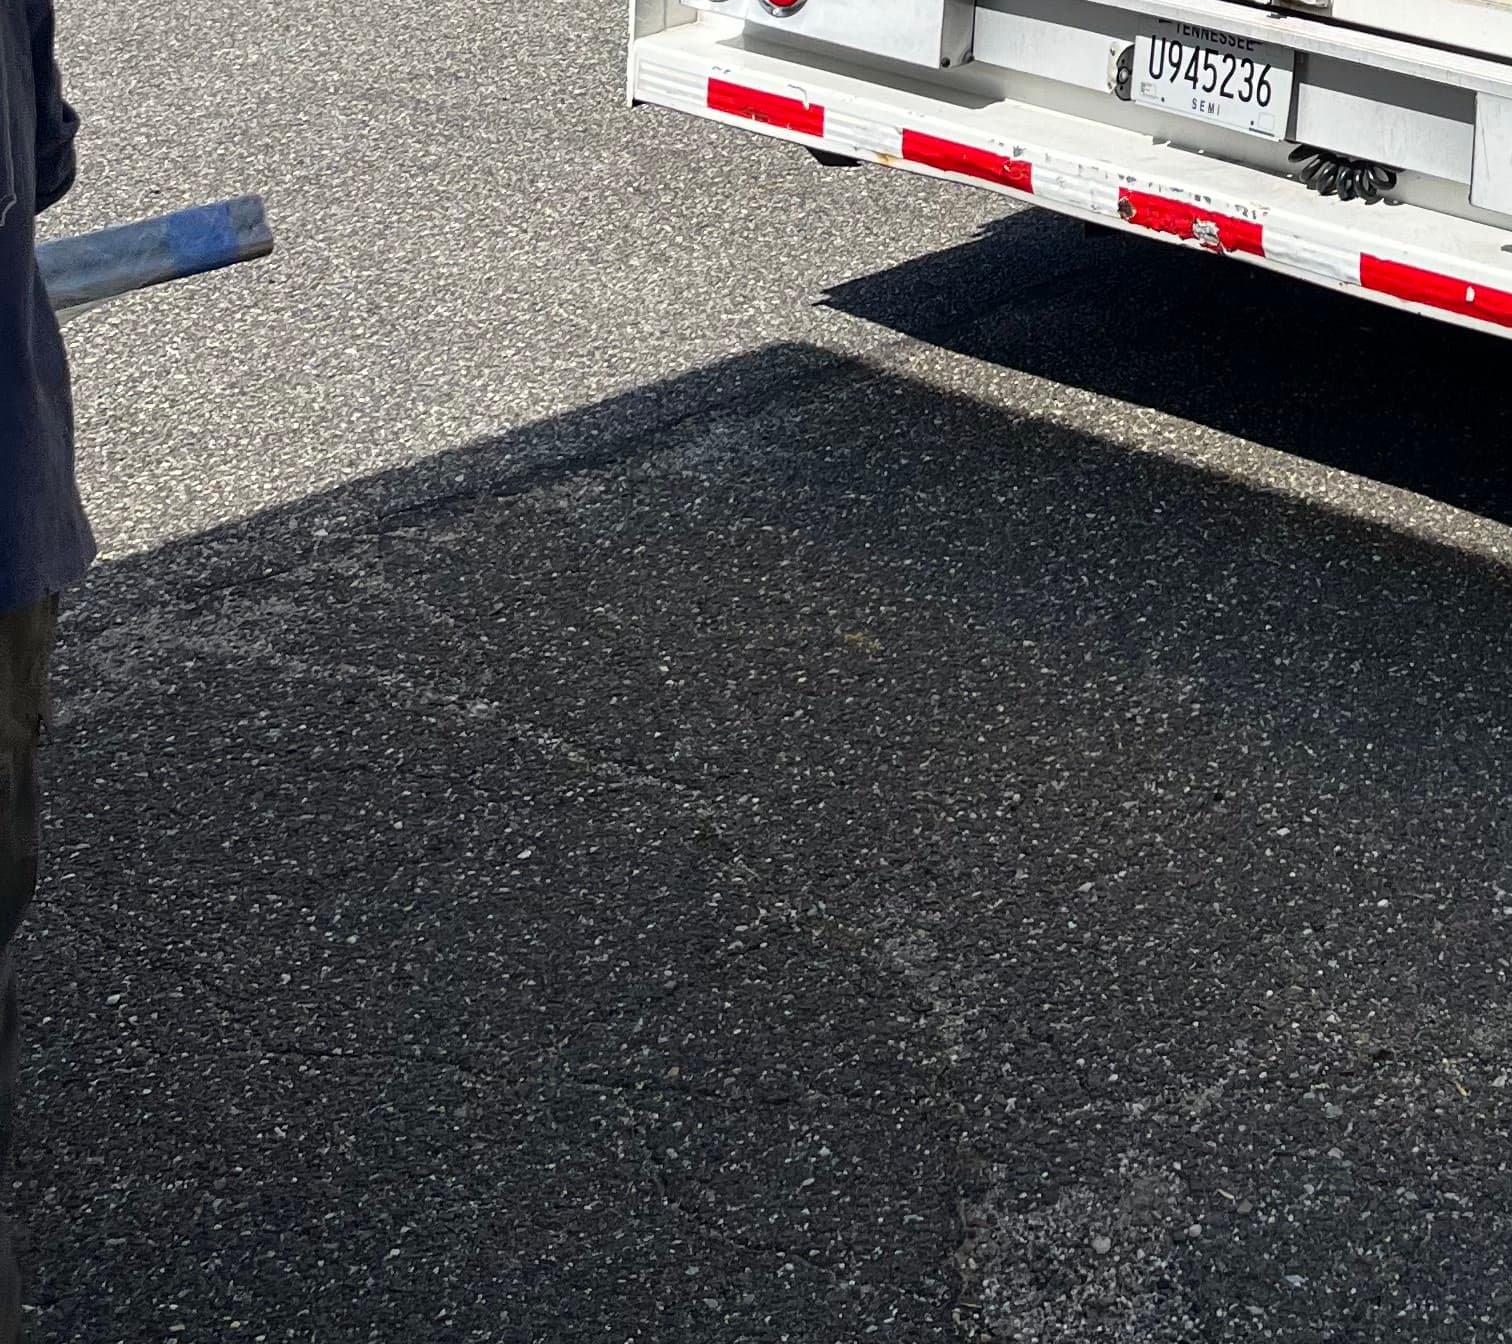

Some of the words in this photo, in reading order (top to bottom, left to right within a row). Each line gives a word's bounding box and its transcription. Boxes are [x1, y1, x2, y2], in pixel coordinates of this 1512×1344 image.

[1175, 21, 1256, 52] TENNESSEE
[1148, 34, 1273, 108] U945236
[1191, 97, 1222, 116] SEMI
